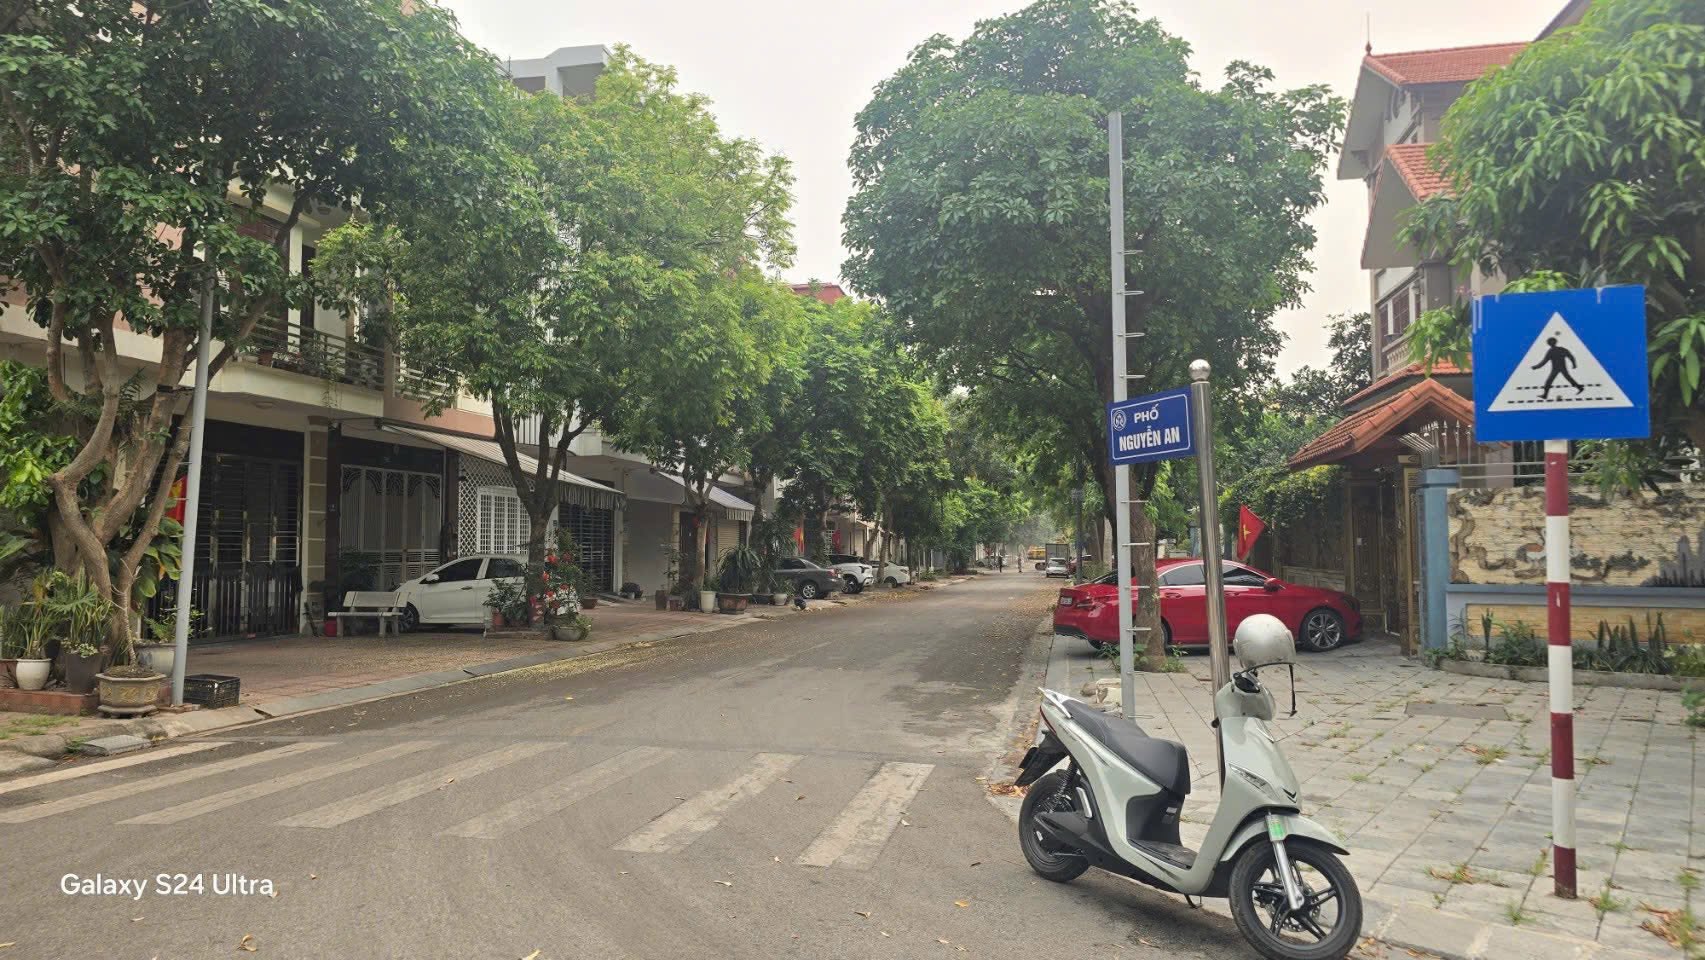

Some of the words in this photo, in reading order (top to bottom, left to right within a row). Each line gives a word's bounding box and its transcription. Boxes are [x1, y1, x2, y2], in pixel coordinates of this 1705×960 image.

[1133, 403, 1159, 424] PHỐ
[1119, 425, 1161, 452] NGUYỄN
[1164, 426, 1180, 445] AN
